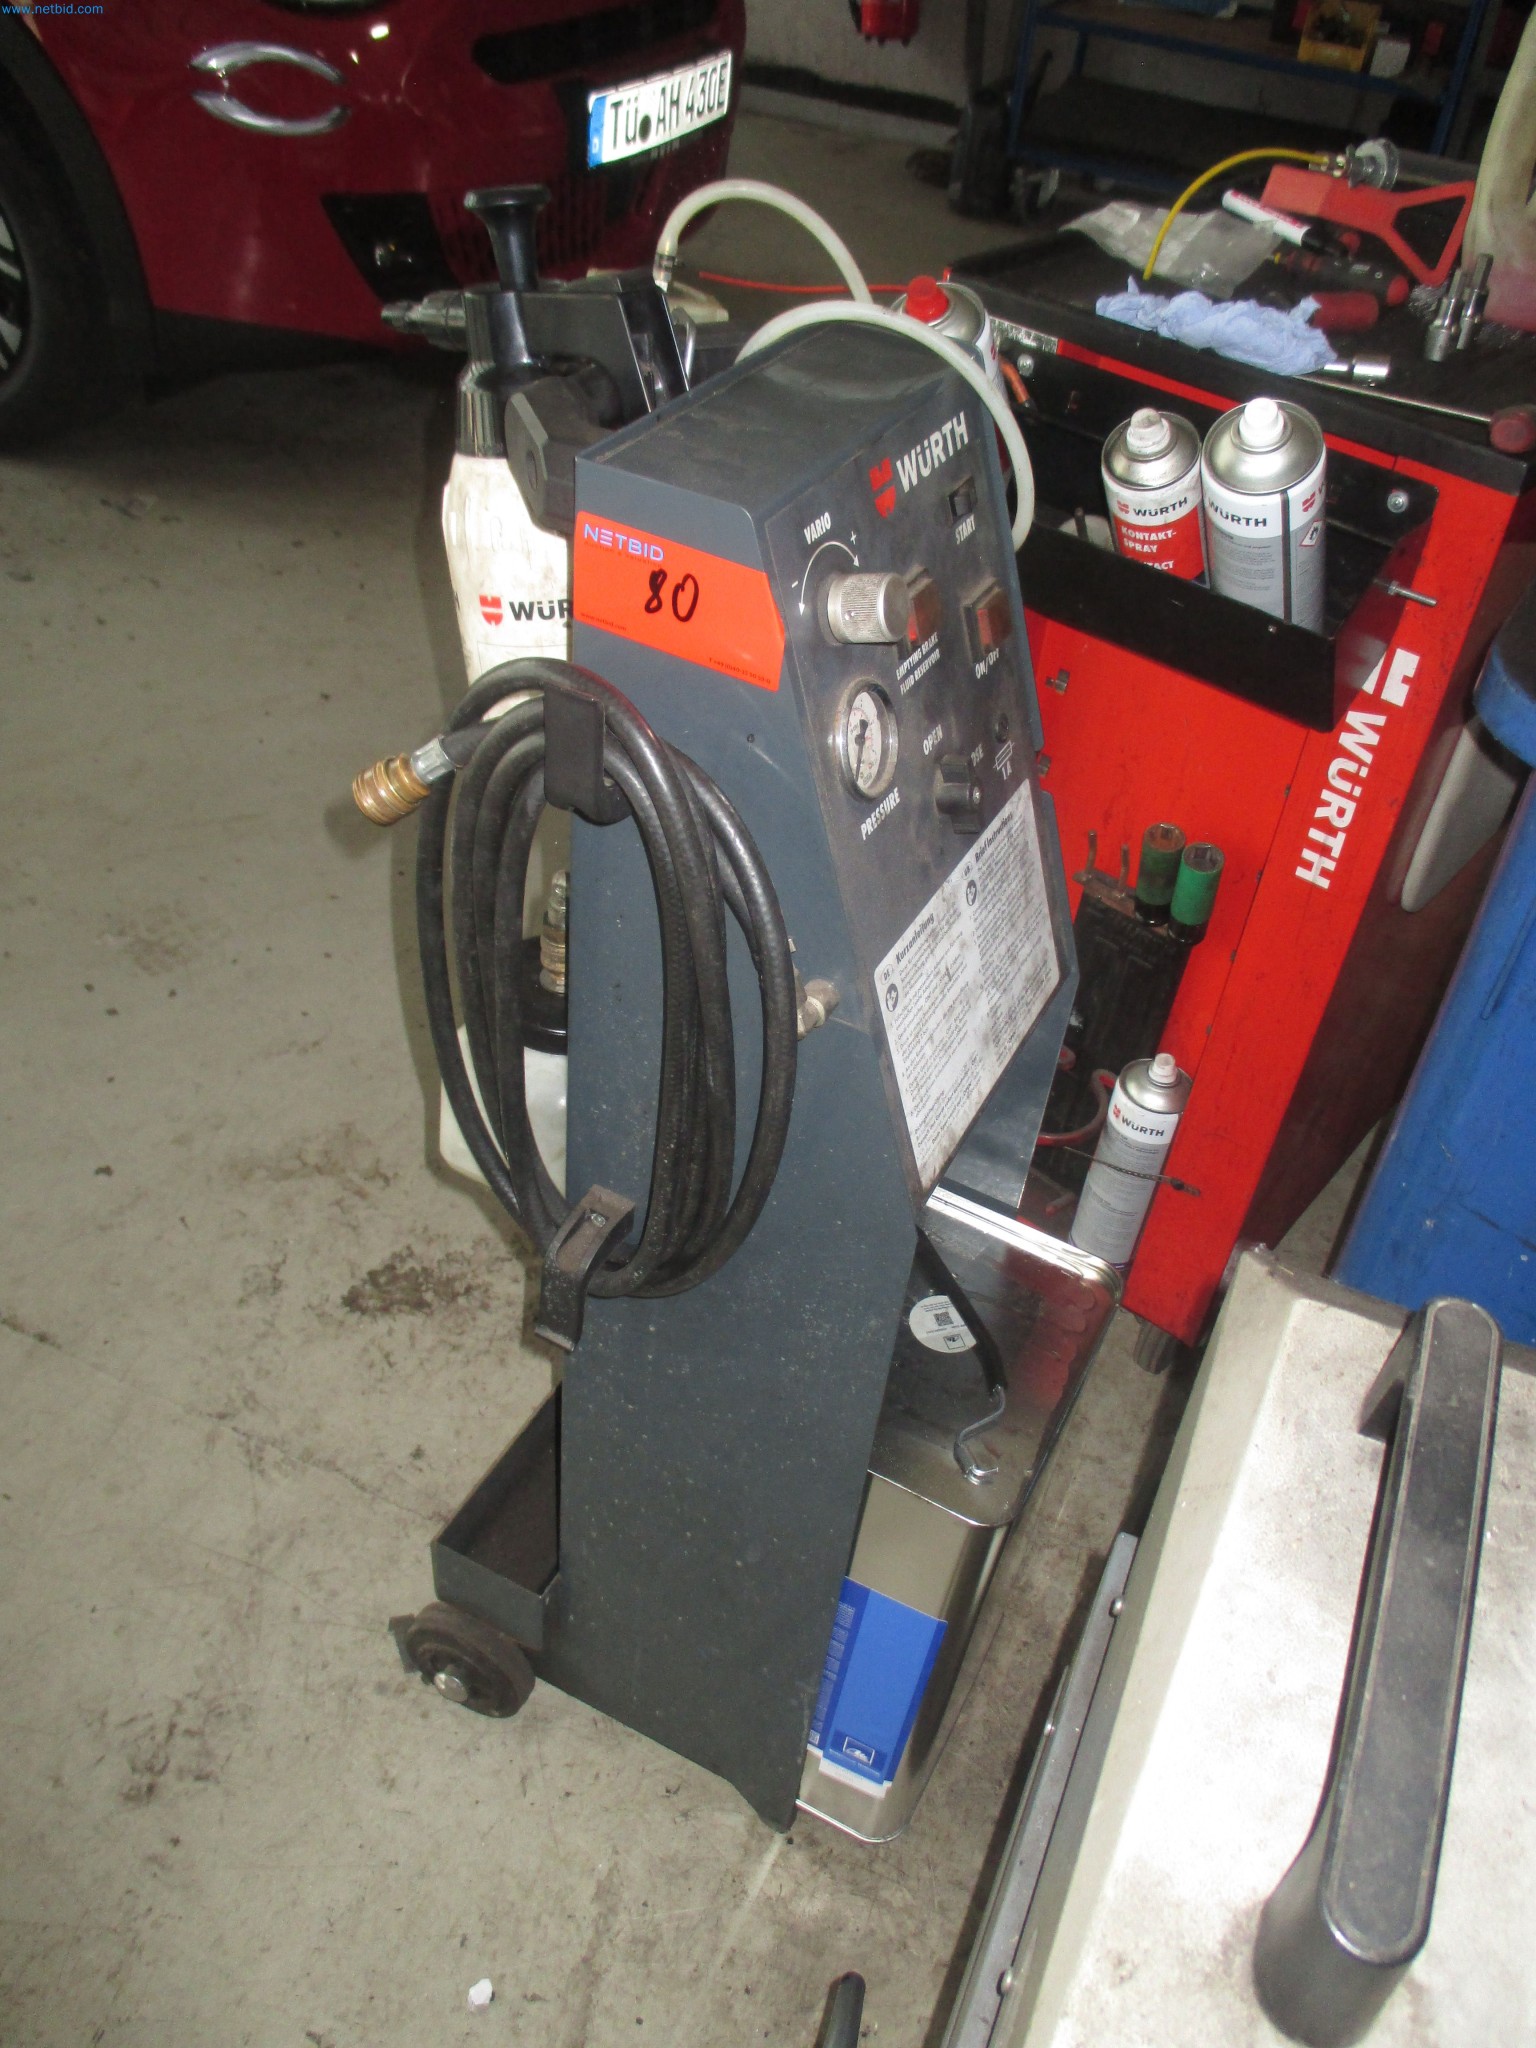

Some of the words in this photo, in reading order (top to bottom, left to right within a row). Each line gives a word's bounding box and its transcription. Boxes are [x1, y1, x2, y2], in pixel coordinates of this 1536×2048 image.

[610, 96, 638, 150] TÜ
[655, 80, 682, 136] AH
[896, 411, 969, 494] WÜRTH
[1132, 497, 1188, 518] WÜRTH
[1208, 498, 1267, 527] WÜRTH
[584, 523, 665, 562] NETBID
[803, 511, 832, 545] VARIO
[955, 514, 976, 545] START
[1121, 526, 1177, 541] KONTAKT-
[1123, 540, 1158, 553] SPRAY
[644, 568, 700, 623] 80
[896, 647, 922, 680] EMPTYING
[914, 648, 941, 682] RESERVOIR
[923, 724, 944, 756] OPEN
[860, 786, 901, 841] PRESSURE
[1295, 711, 1388, 889] WÜRTH
[895, 912, 936, 965] Kurzanleitung
[1121, 1116, 1165, 1137] WÜRTH
